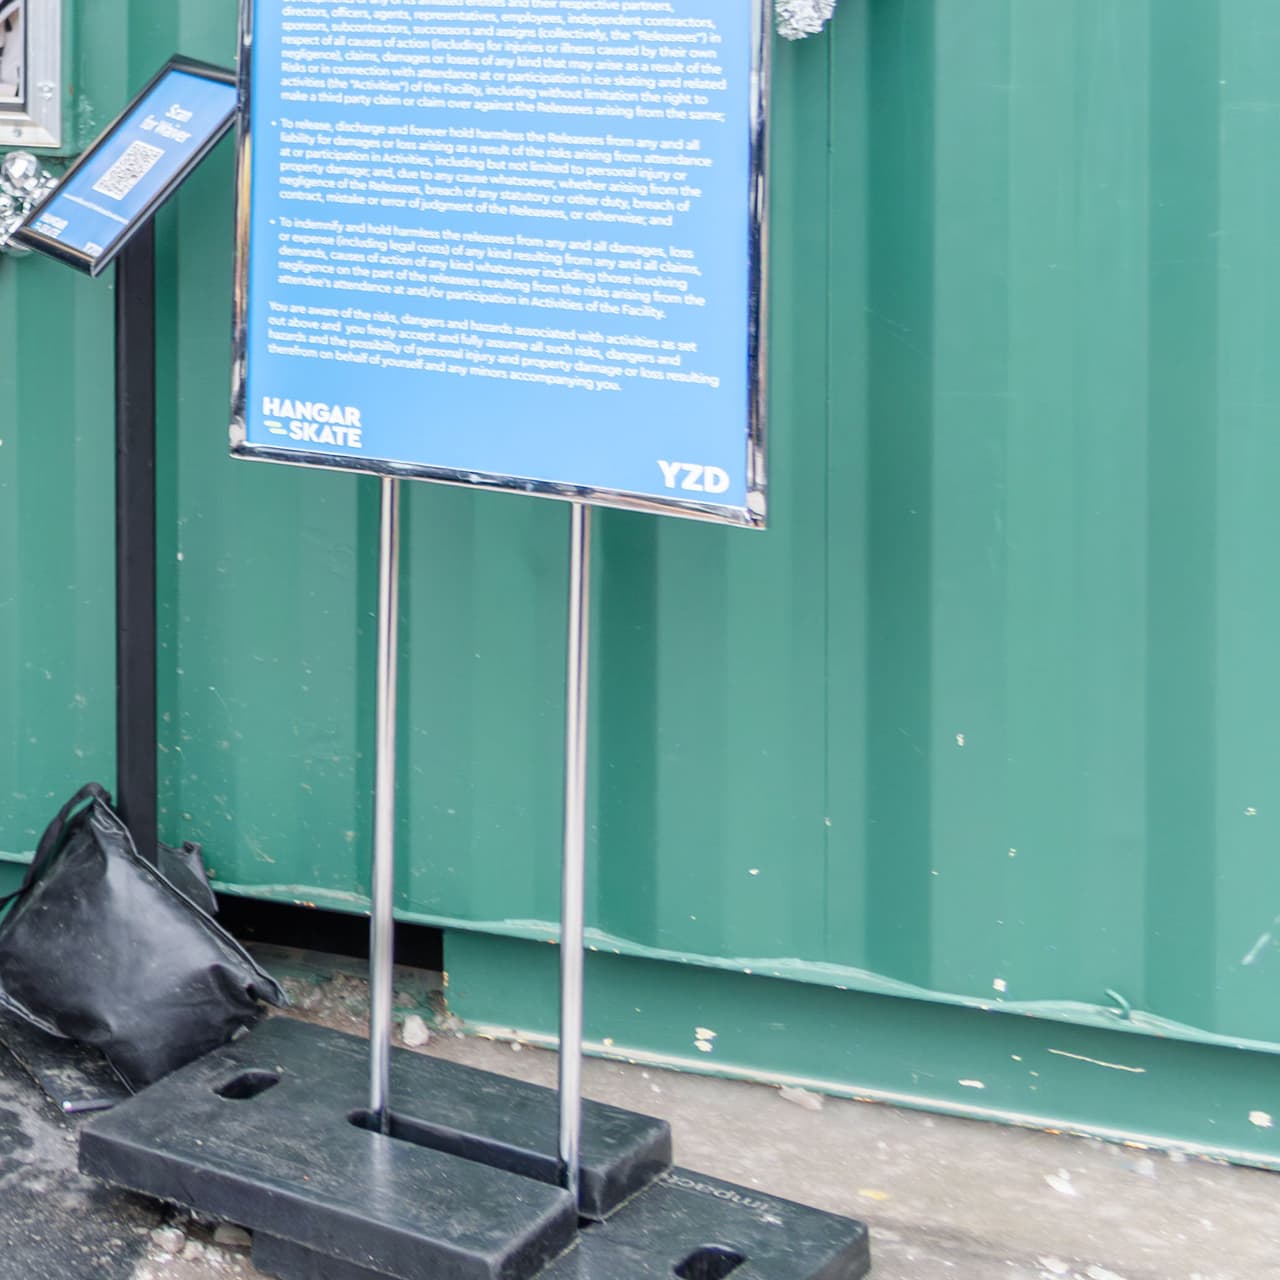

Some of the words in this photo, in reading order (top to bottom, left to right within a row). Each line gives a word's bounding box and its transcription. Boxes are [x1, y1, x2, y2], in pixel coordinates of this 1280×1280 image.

[262, 396, 361, 427] HANGAR
[288, 420, 362, 448] SKATE
[657, 460, 730, 493] YZD
